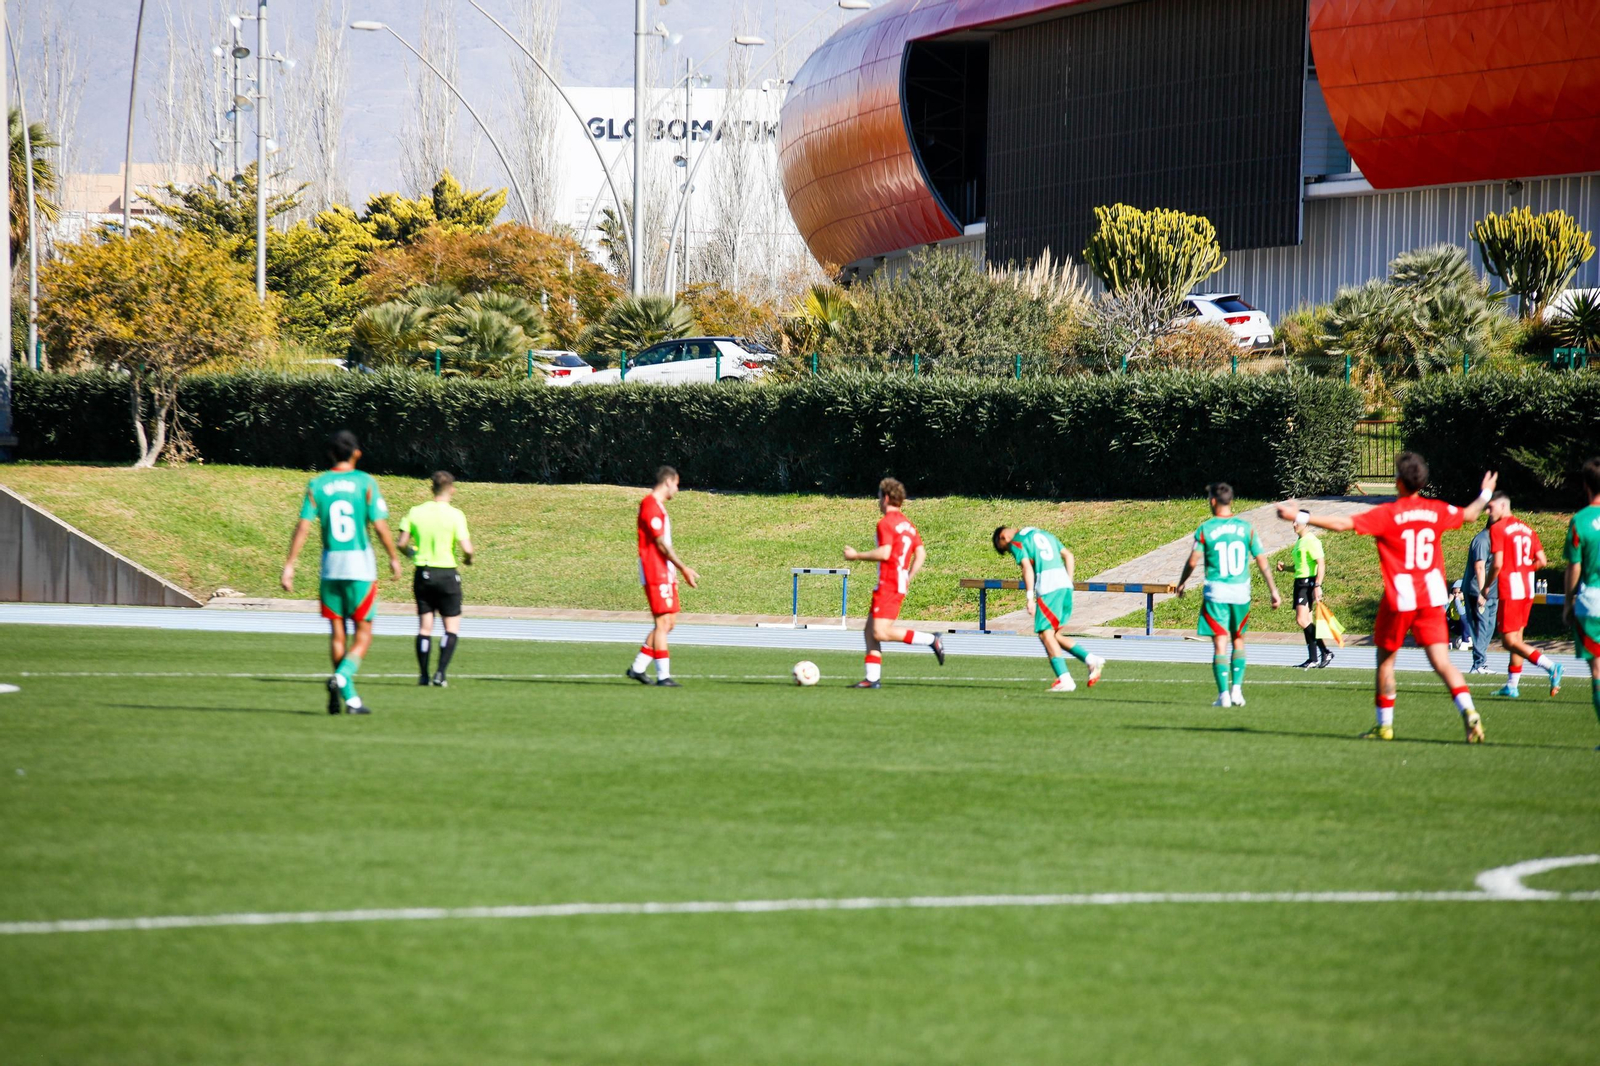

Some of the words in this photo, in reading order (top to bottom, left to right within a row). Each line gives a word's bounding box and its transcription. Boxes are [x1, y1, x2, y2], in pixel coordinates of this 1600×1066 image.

[586, 117, 779, 142] GLOBOMIK
[329, 500, 355, 542] 6
[1033, 533, 1054, 561] 9
[1214, 541, 1246, 577] 10
[1401, 528, 1436, 570] 16
